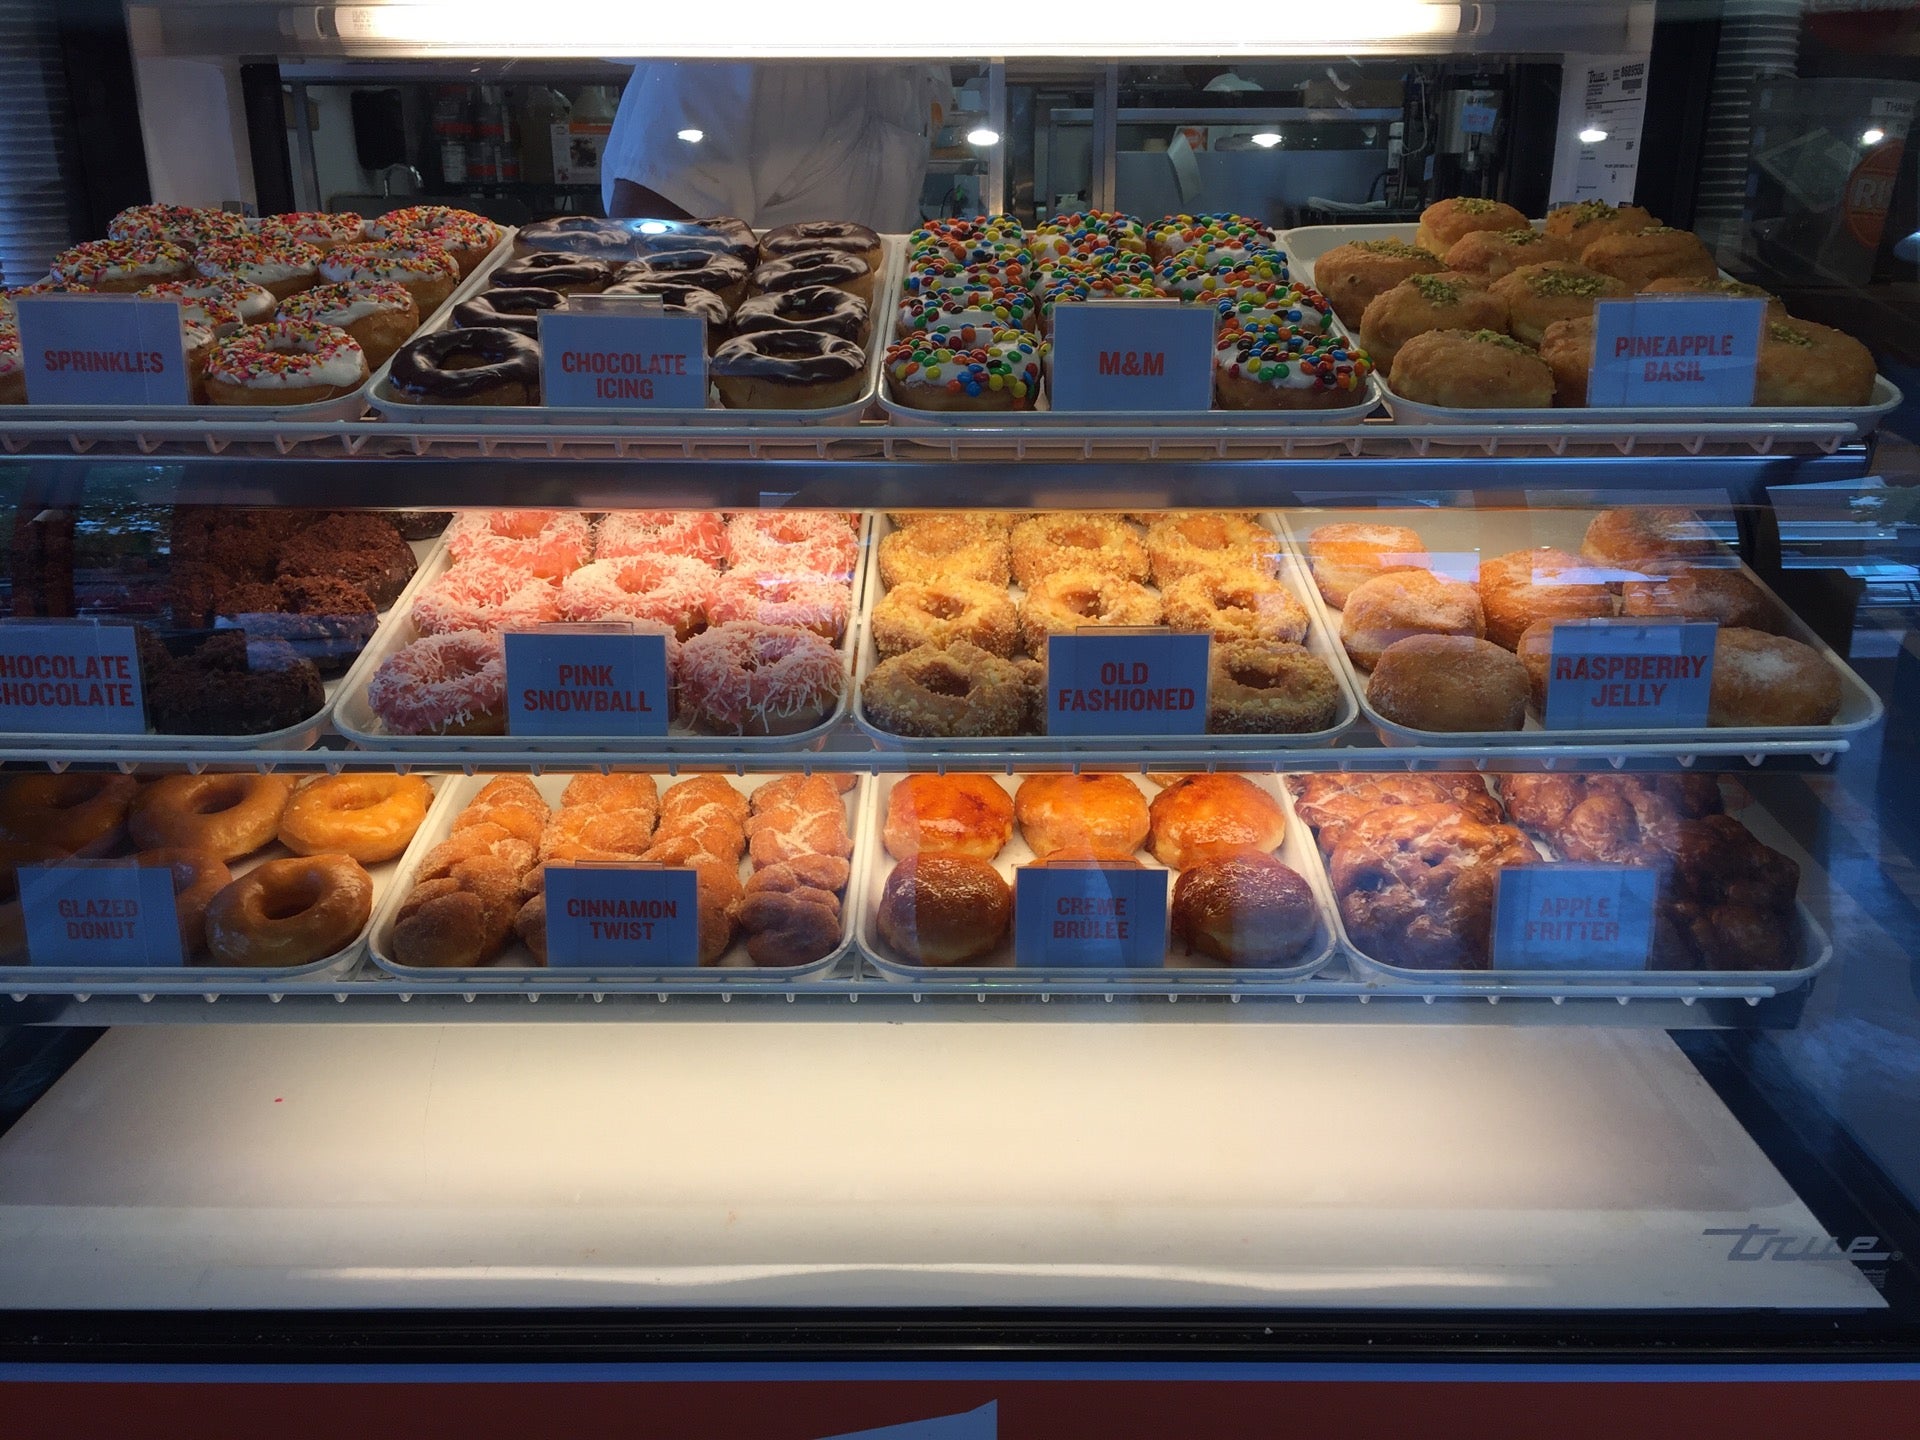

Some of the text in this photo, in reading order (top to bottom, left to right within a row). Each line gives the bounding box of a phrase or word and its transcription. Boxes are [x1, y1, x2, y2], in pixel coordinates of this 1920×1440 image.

[1615, 335, 1734, 357] PINEAPPLE
[44, 350, 165, 374] SPRINKLES
[561, 351, 687, 375] CHOCOLATE
[1098, 351, 1165, 376] M&M
[1645, 361, 1706, 382] BASIL
[596, 377, 654, 399] ICING
[0, 655, 131, 679] HOCOLATE
[558, 664, 614, 686] PINK
[1100, 662, 1149, 685] OLD
[1555, 655, 1708, 680] RASPBERRY
[0, 682, 135, 706] HOCOLATE
[523, 689, 652, 712] SNOWBALL
[1058, 688, 1195, 711] FASHIONED
[1591, 685, 1667, 706] JELLY
[58, 899, 139, 918] GLAZED
[566, 899, 678, 919] CINNAMON
[1539, 898, 1611, 918] APPLE
[66, 921, 136, 940] DONUT
[589, 921, 655, 940] TWIST
[1524, 921, 1620, 941] FRITTER
